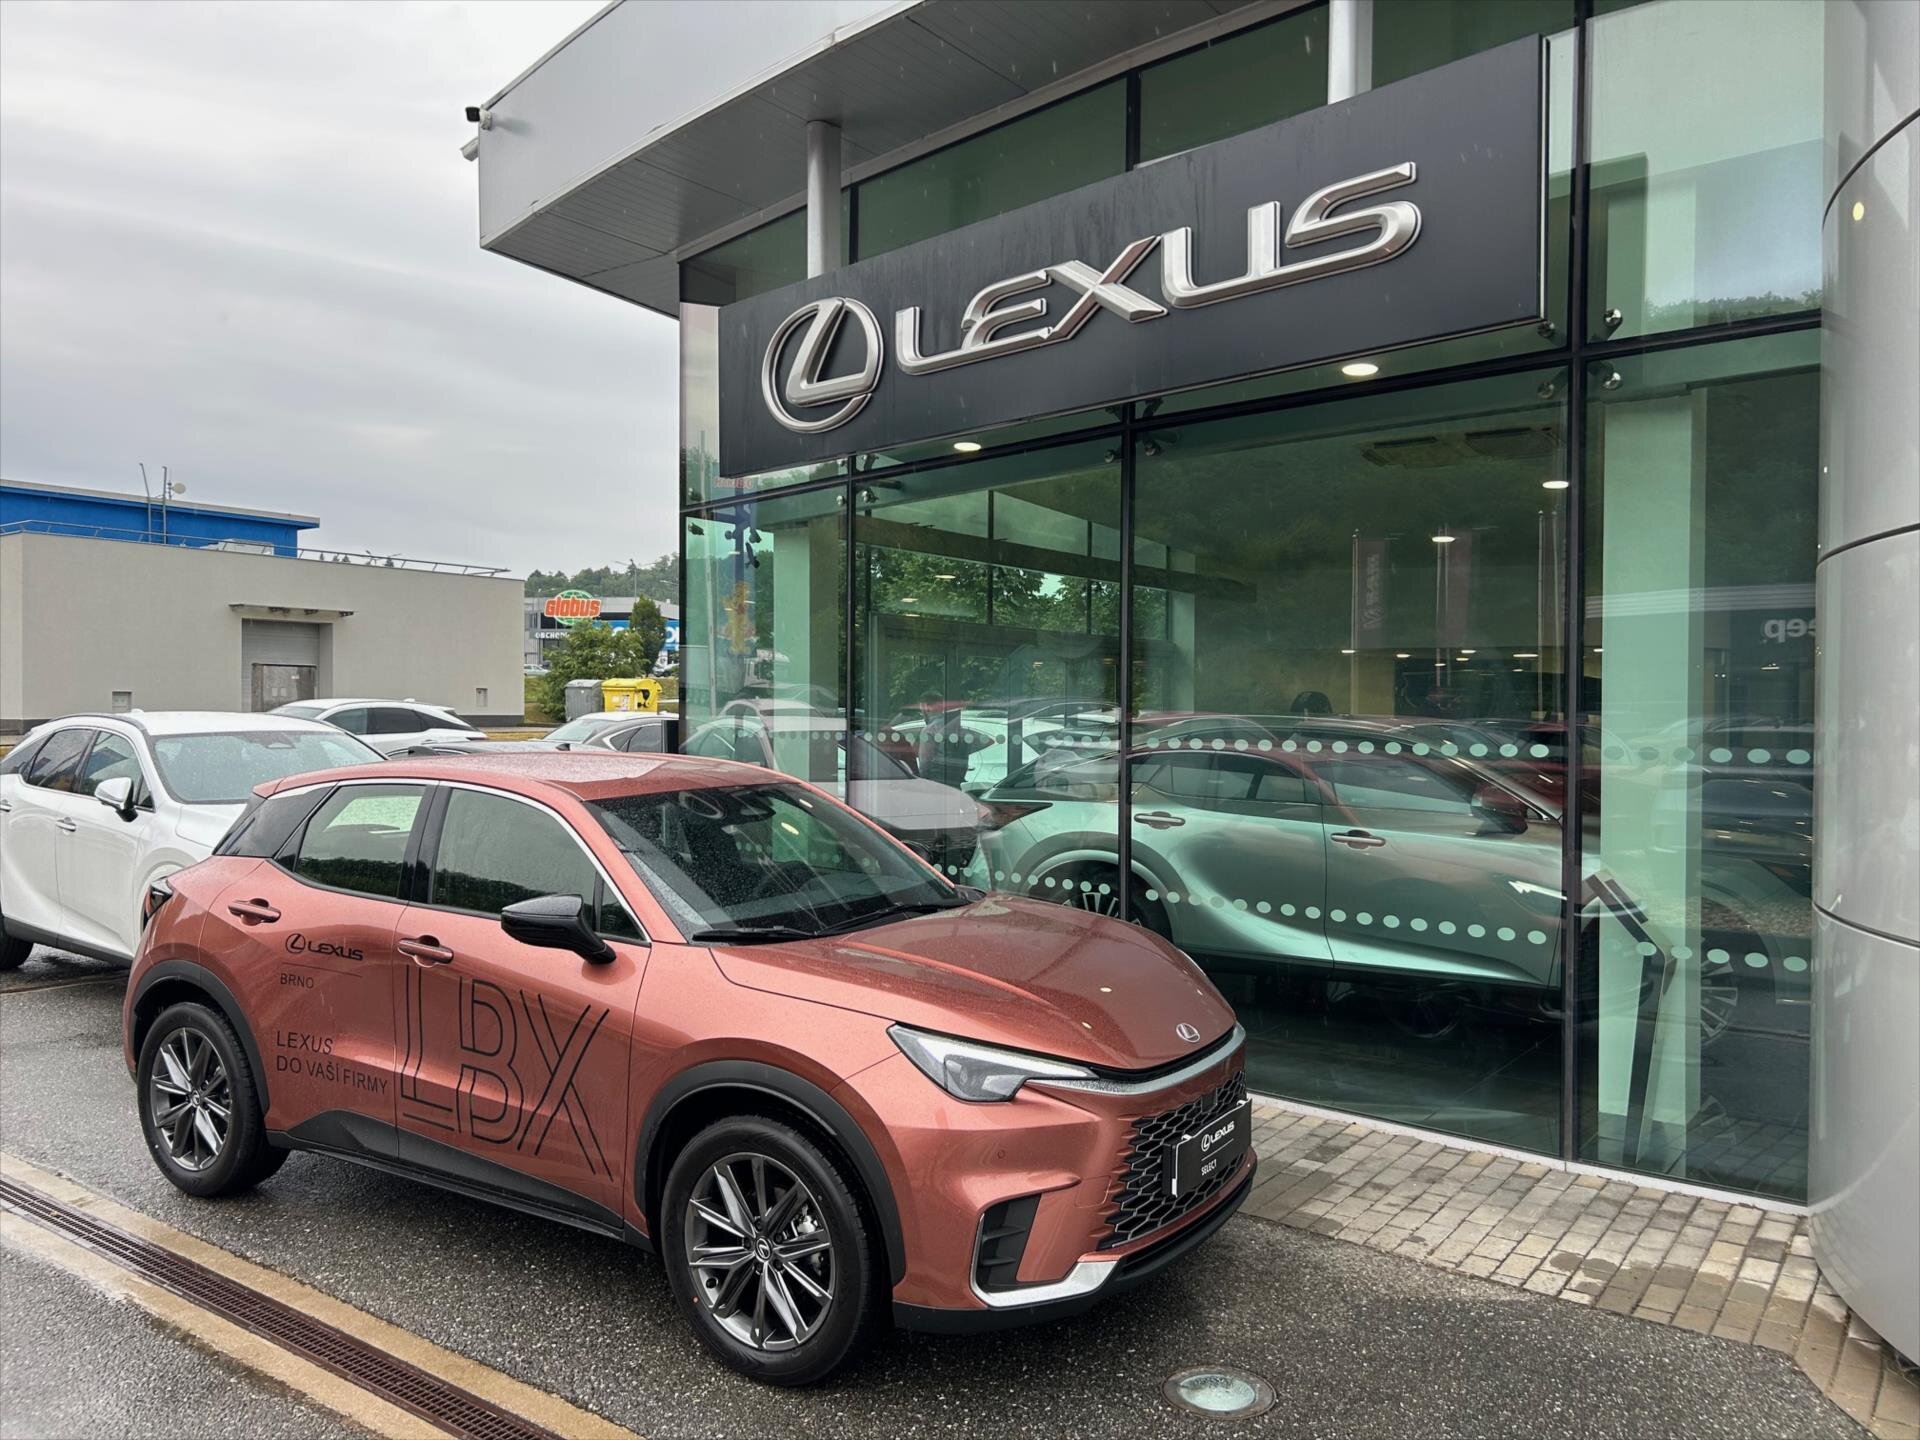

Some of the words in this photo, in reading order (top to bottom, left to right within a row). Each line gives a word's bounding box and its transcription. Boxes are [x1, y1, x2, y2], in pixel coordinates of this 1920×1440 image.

[895, 161, 1422, 375] LEXUS
[308, 940, 364, 961] LEXUS
[280, 973, 314, 989] BRNO
[276, 1030, 333, 1055] LEXUS
[276, 1055, 302, 1074] DO
[305, 1060, 340, 1083] VAŠÍ
[343, 1069, 388, 1095] FIRMY
[400, 964, 614, 1182] LBX
[1210, 1121, 1235, 1143] LEXUS
